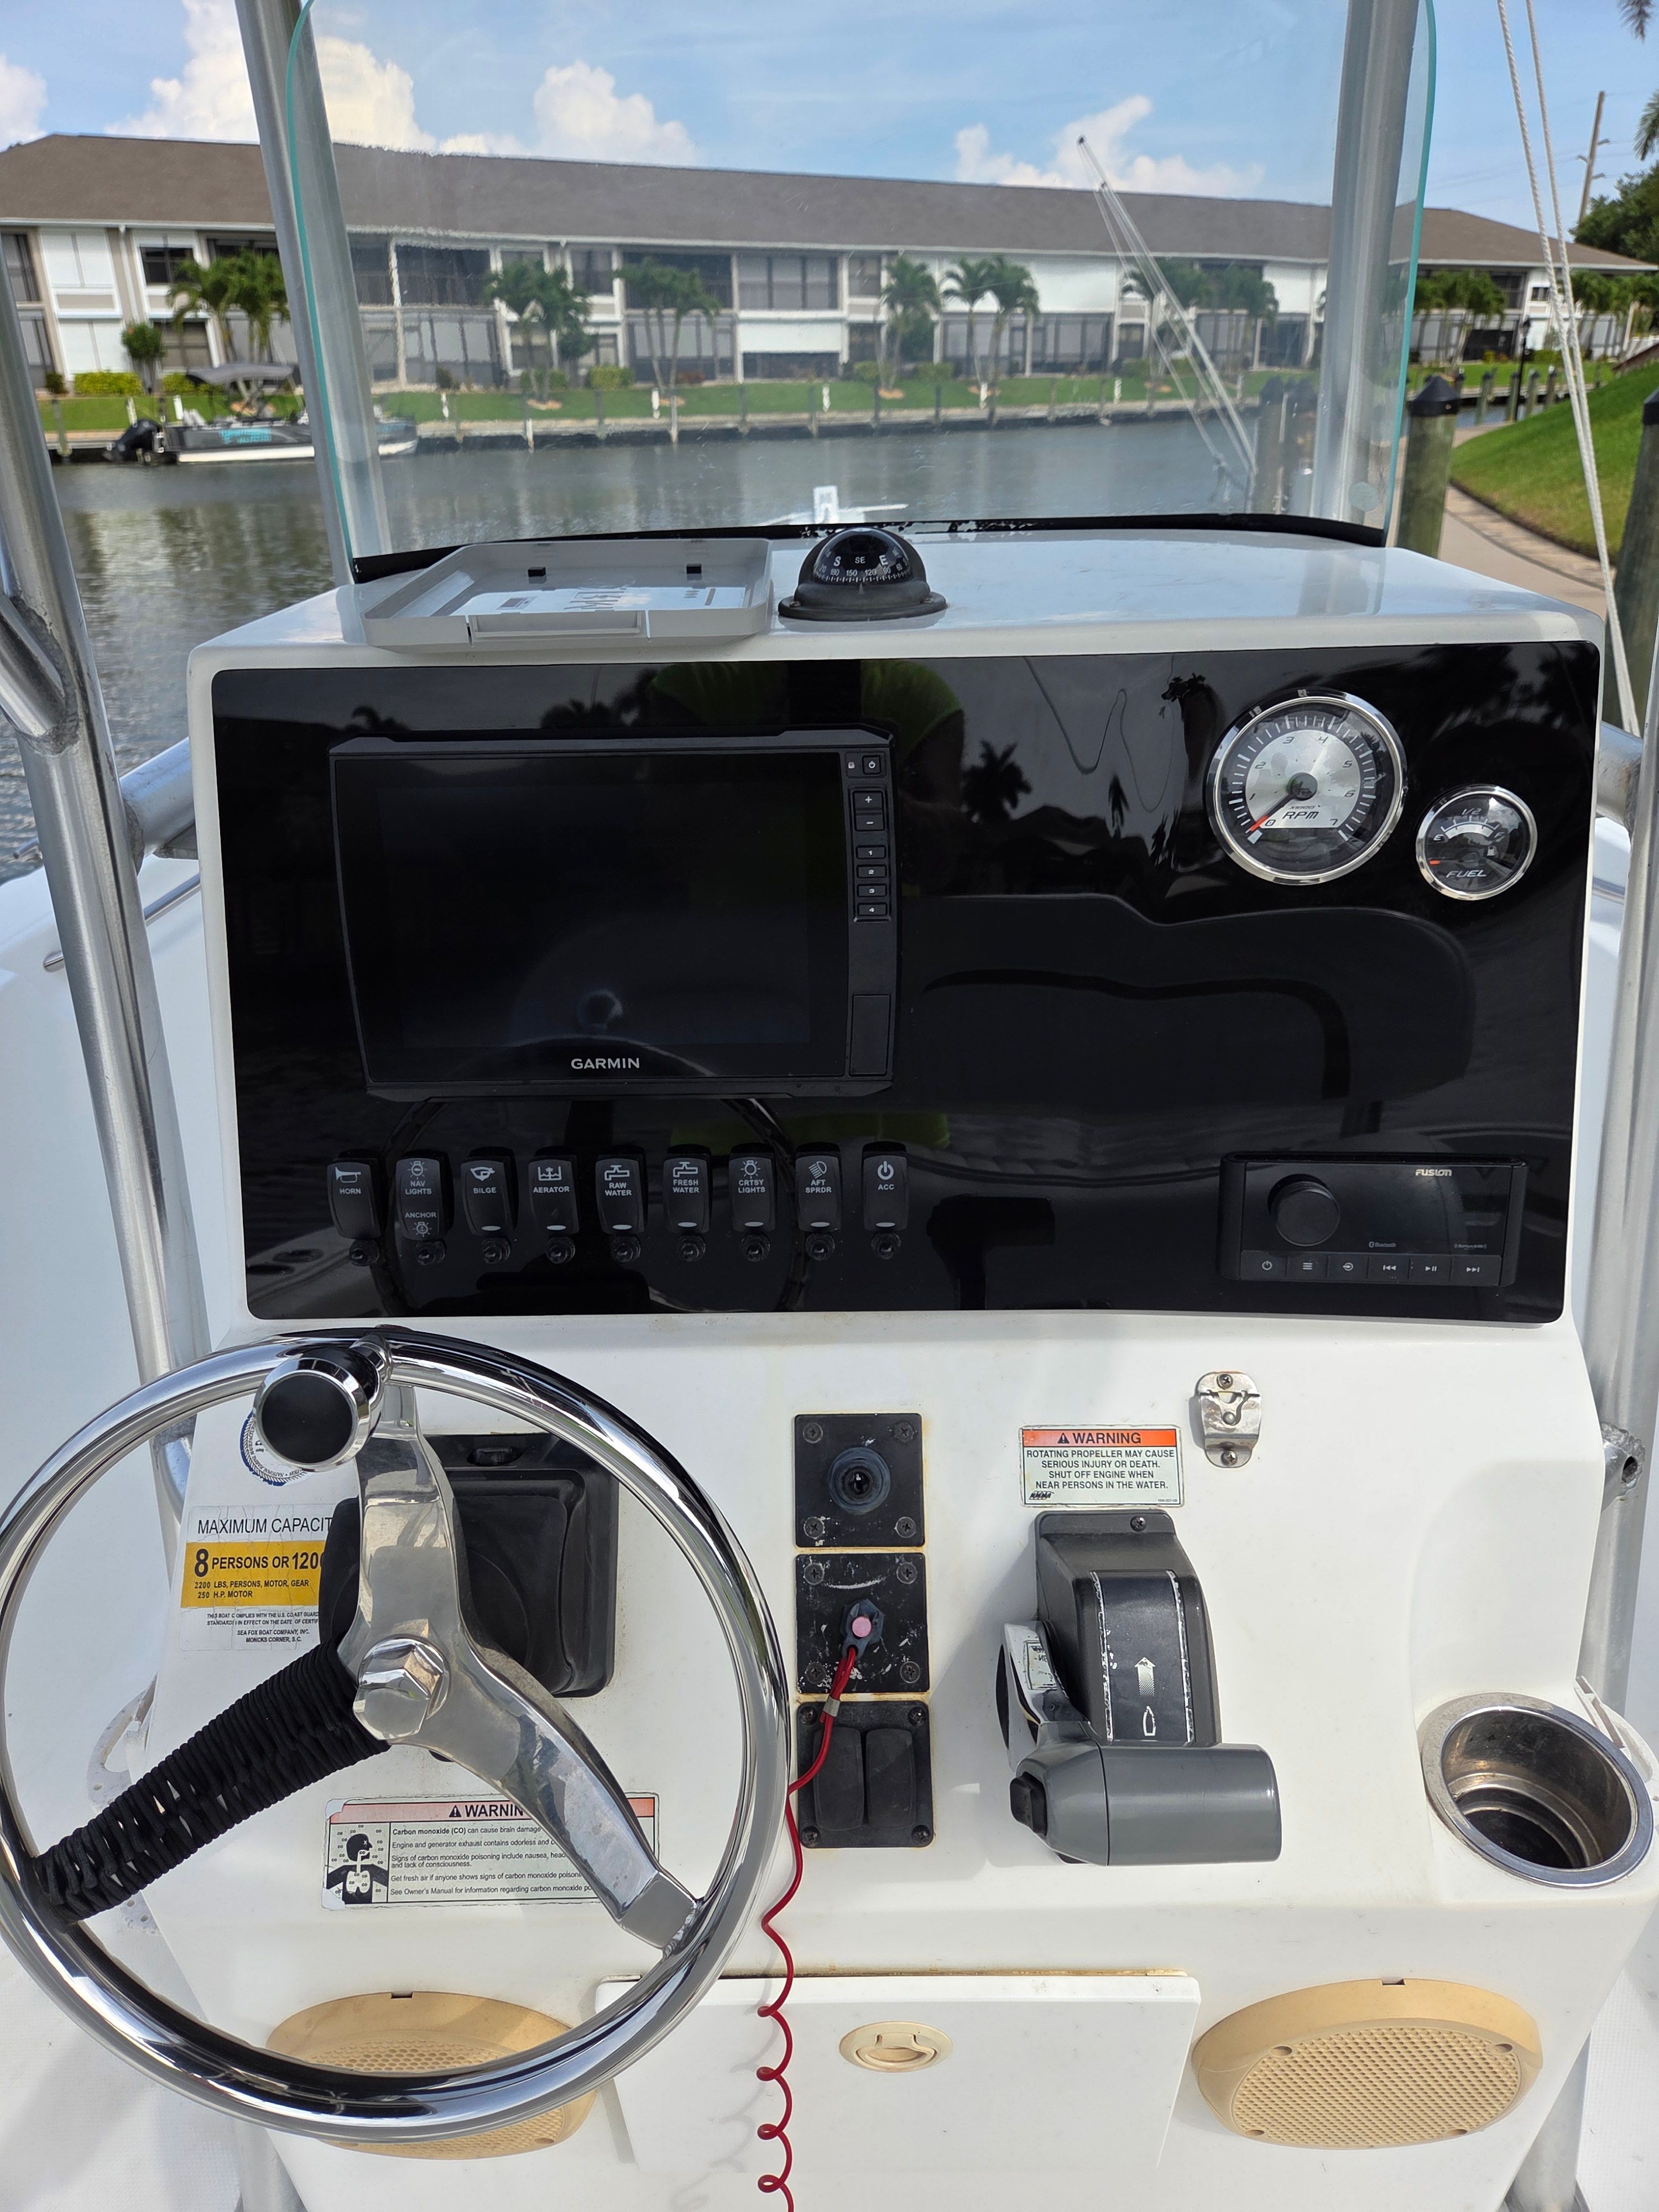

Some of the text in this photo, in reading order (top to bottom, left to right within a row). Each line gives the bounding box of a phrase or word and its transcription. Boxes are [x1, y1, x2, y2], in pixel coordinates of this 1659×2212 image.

[833, 556, 841, 567] S
[879, 555, 888, 566] E
[1282, 811, 1319, 820] RPM
[571, 1057, 640, 1070] GARMIN
[1073, 1432, 1141, 1444] WARNING
[1027, 1449, 1175, 1458] ROTATING PROPELLER MAY CAUSE
[1082, 1460, 1111, 1468] INJURY
[1129, 1470, 1154, 1478] WHEN
[198, 1517, 332, 1534] MAXIMUM CAPACIT
[195, 1548, 325, 1577] 8 PERSONS OR 120
[230, 1580, 262, 1588] PERSONS,
[465, 1804, 523, 1817] WARNIN
[516, 1826, 541, 1834] damage
[393, 1842, 413, 1850] Engine
[427, 1840, 456, 1849] generator
[392, 1855, 409, 1863] Signs
[471, 1853, 500, 1861] poisoning
[500, 1886, 529, 1894] regarding
